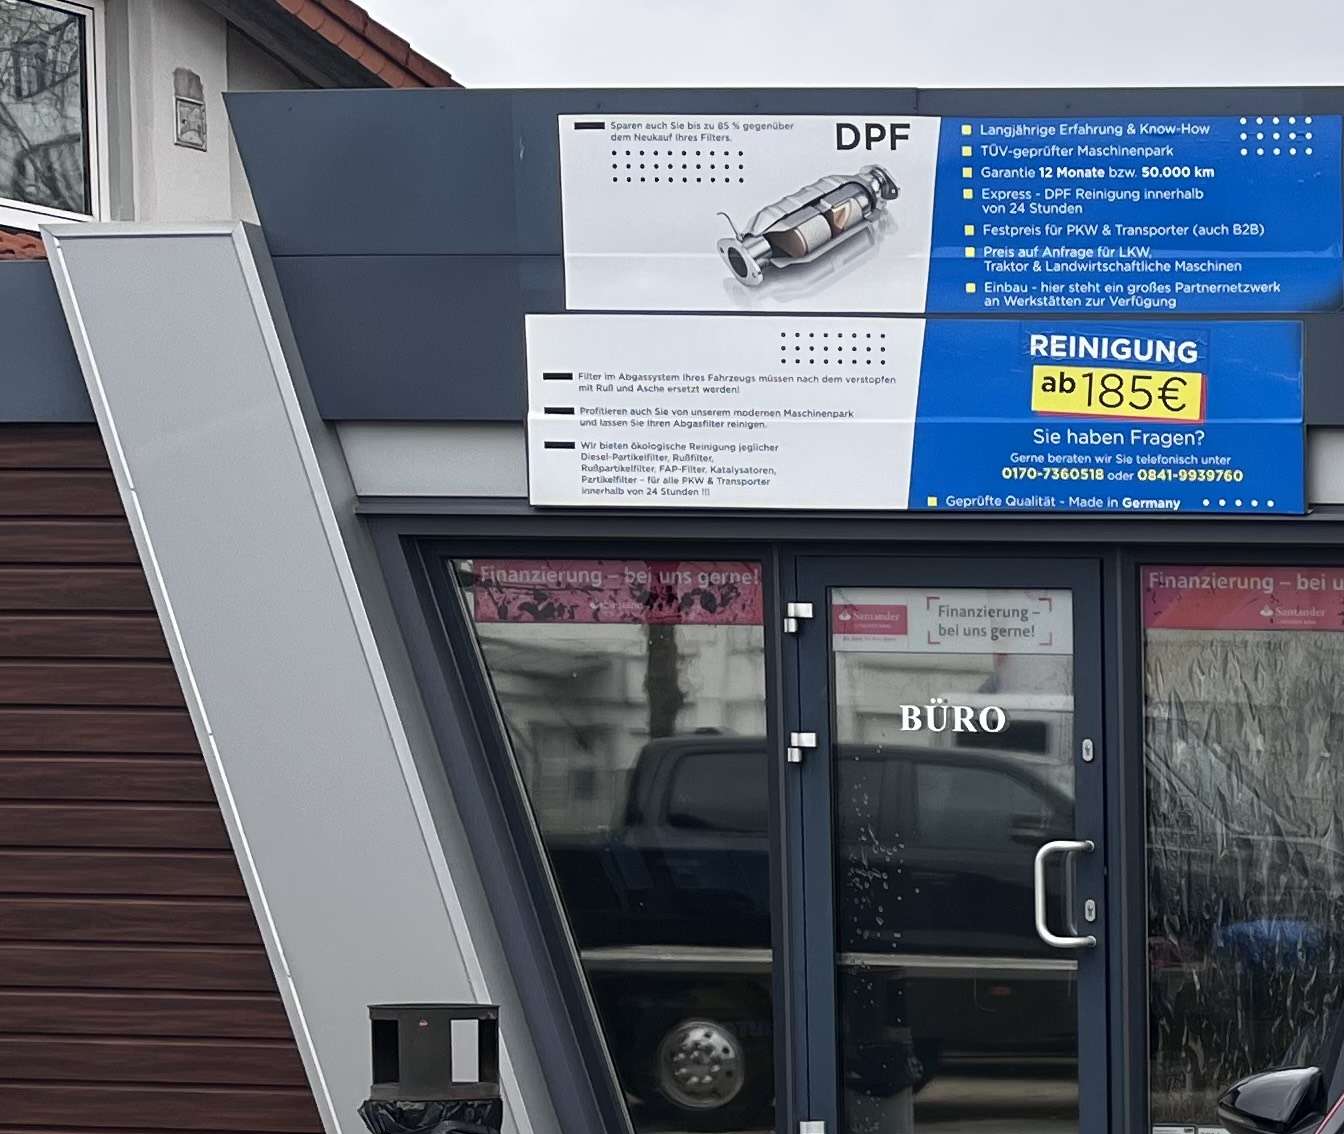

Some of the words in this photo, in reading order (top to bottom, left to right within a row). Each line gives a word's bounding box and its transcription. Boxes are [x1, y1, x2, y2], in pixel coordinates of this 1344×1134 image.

[610, 121, 642, 130] Sparen
[645, 121, 667, 129] auch
[742, 121, 794, 131] gegenüber
[980, 123, 1056, 138] Langjährige
[1059, 123, 1123, 136] Erfahrung
[1126, 123, 1136, 134] &
[1139, 122, 1210, 134] Know-How
[633, 132, 672, 141] Neukauf
[675, 133, 697, 141] Ihres
[836, 122, 910, 150] DPF
[980, 143, 1073, 159] TÜV-geprüfter
[1077, 144, 1173, 157] Maschinenpark
[980, 166, 1035, 178] Garantie
[1038, 166, 1052, 178] 12
[1056, 166, 1105, 178] Monate
[1108, 166, 1136, 178] bzw.
[1141, 166, 1190, 177] 50.000
[1194, 166, 1214, 177] km
[981, 187, 1031, 200] Express
[1044, 187, 1071, 199] DPF
[1075, 188, 1140, 202] Reinigung
[1144, 187, 1204, 199] innerhalb
[981, 204, 1006, 214] von
[1009, 202, 1025, 214] 24
[1029, 202, 1083, 214] Stunden
[982, 224, 1041, 237] Festpreis
[1044, 224, 1062, 235] für
[1066, 224, 1098, 235] PKW
[1101, 224, 1111, 235] &
[1114, 223, 1189, 236] Transporter
[1192, 223, 1229, 236] (auch
[1232, 223, 1264, 235] B2B)
[983, 245, 1015, 258] Preis
[1017, 245, 1039, 258] auf
[1041, 245, 1094, 259] Anfrage
[1097, 246, 1115, 258] für
[983, 260, 1029, 272] Traktor
[1032, 260, 1041, 272] &
[1045, 260, 1171, 272] Landwirtschaftliche
[1174, 260, 1242, 272] Maschinen
[984, 281, 1028, 293] Einbau
[1040, 281, 1065, 292] hier
[1068, 281, 1100, 293] steht
[1104, 284, 1123, 293] ein
[1126, 281, 1171, 294] großes
[1175, 281, 1280, 293] Partnernetzwerk
[983, 297, 999, 306] an
[1003, 295, 1081, 306] Werkstätten
[1085, 297, 1105, 306] zur
[1109, 295, 1176, 309] Verfügung
[1030, 334, 1198, 363] REINIGUNG
[578, 372, 601, 380] Filter
[618, 372, 679, 382] Abgassystem
[682, 373, 705, 382] Ihres
[707, 373, 756, 383] Fahrzeugs
[758, 374, 794, 383] müssen
[796, 375, 819, 383] nach
[821, 375, 842, 383] dem
[845, 375, 896, 385] verstopfen
[616, 384, 633, 392] und
[636, 384, 664, 392] Asche
[667, 385, 699, 393] ersetzt
[1041, 372, 1076, 394] ab
[1082, 372, 1187, 412] 185€
[579, 406, 628, 415] Profitieren
[629, 407, 652, 416] auch
[733, 409, 781, 417] modernen
[783, 408, 854, 418] Maschinenpark
[579, 419, 597, 427] und
[672, 419, 724, 429] Abgasfilter
[1033, 428, 1060, 444] Sie
[1067, 428, 1124, 445] haben
[1130, 429, 1205, 448] Fragen?
[580, 441, 596, 449] Wir
[599, 441, 628, 450] bieten
[630, 441, 686, 452] ökologische
[688, 442, 736, 452] Reinigung
[1009, 452, 1044, 463] Gerne
[1047, 453, 1091, 464] beraten
[1094, 455, 1112, 463] wir
[1115, 453, 1133, 464] Sie
[1135, 454, 1198, 465] telefonisch
[1200, 455, 1231, 465] unter
[710, 465, 776, 475] Katalysatoren,
[1001, 467, 1104, 480] 0170-7360518
[1107, 470, 1134, 480] oder
[1137, 468, 1243, 482] 0841-9939760
[662, 476, 679, 484] alle
[681, 476, 704, 484] PKW
[716, 476, 770, 486] Transporter
[660, 487, 699, 496] Stunden
[945, 494, 1002, 508] Geprüfte
[1005, 495, 1055, 507] Qualität
[1068, 496, 1103, 508] Made
[1107, 498, 1118, 507] in
[1121, 497, 1180, 510] Germany
[480, 566, 602, 585] Finanzierung
[624, 567, 652, 583] bei
[659, 571, 692, 584] uns
[698, 569, 760, 586] gerne!
[1149, 571, 1274, 593] Finanzierung
[1296, 573, 1326, 590] bei
[938, 604, 1028, 621] Finanzierung
[938, 624, 959, 636] bei
[963, 626, 987, 637] uns
[990, 625, 1034, 641] gerne!
[900, 698, 1006, 732] BÜRO
